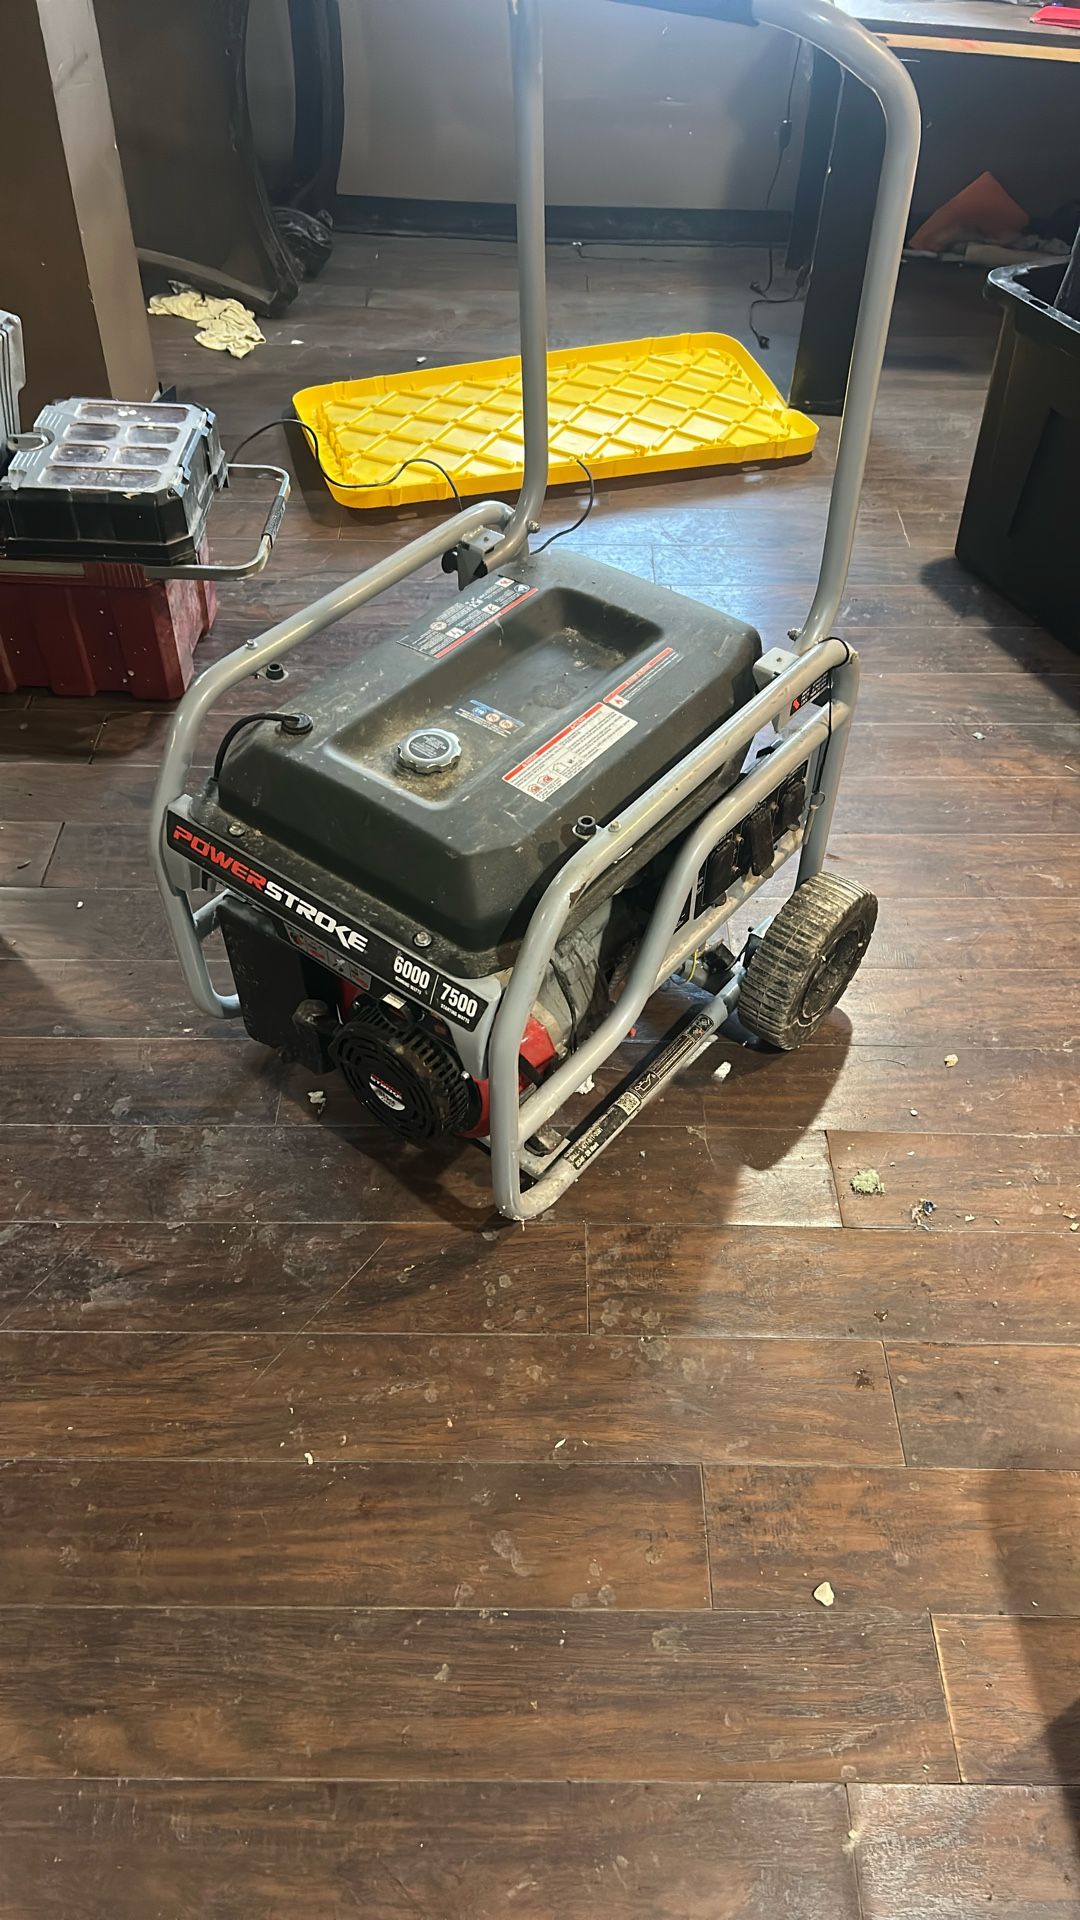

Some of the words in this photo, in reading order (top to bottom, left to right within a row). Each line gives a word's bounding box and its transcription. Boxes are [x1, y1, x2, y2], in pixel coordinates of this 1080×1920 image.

[173, 824, 369, 953] POWERSTROKE
[393, 955, 431, 989] 6000
[440, 982, 478, 1018] 7500
